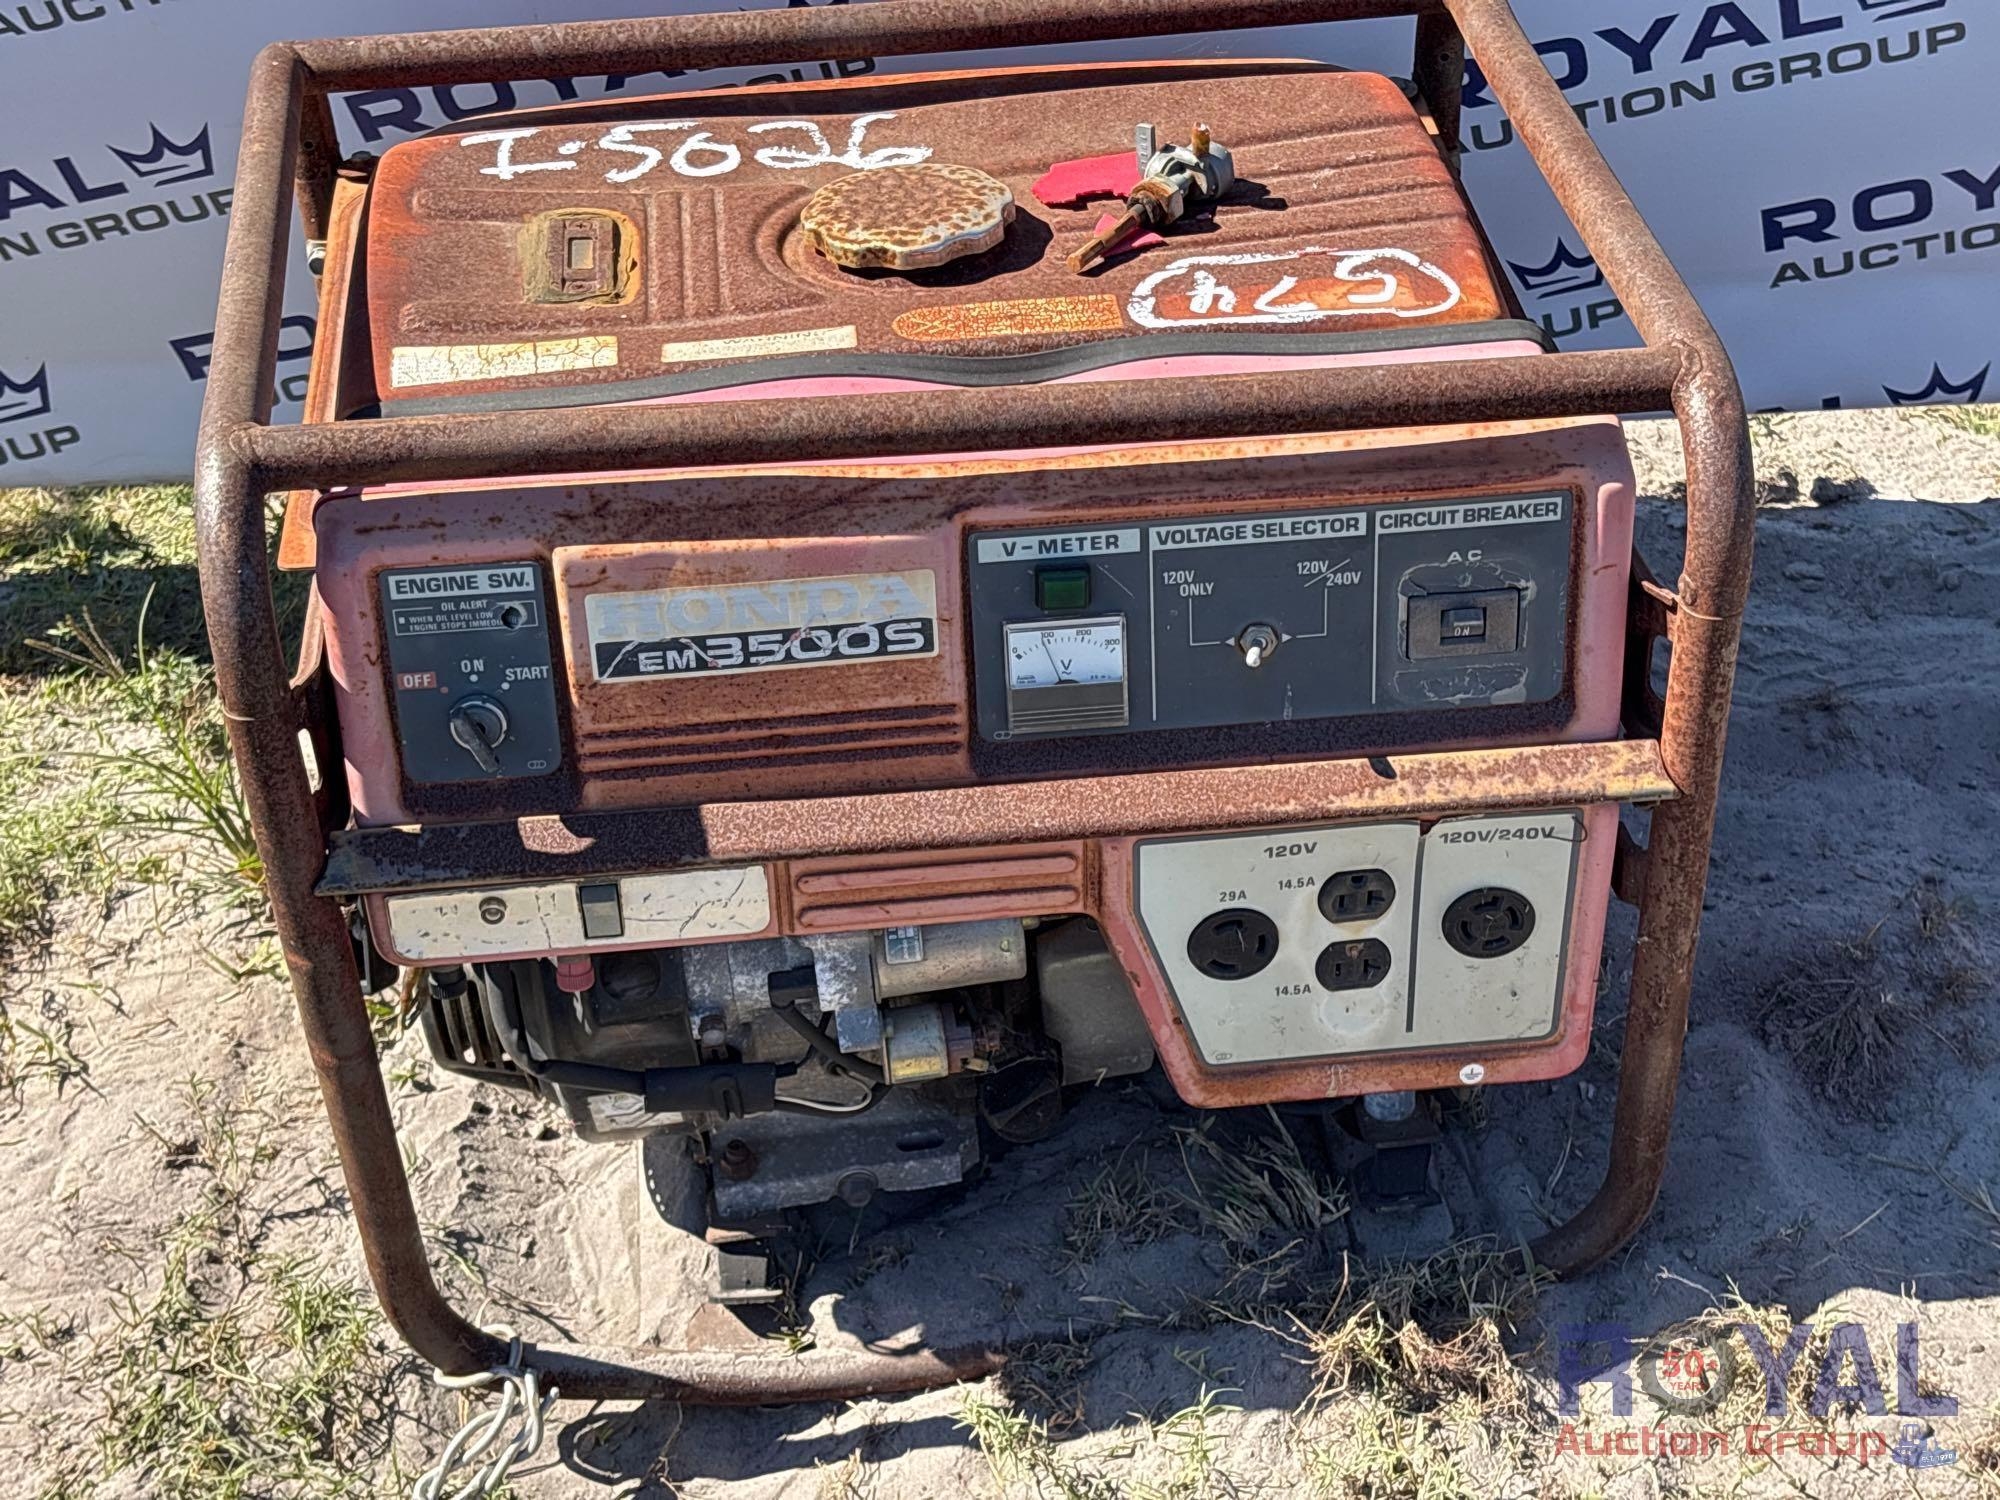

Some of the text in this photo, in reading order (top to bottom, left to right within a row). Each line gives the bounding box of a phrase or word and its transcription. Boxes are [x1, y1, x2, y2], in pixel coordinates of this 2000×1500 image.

[1731, 22, 1967, 94] GROUP
[1379, 502, 1559, 530] CIRCUIT BREAKER
[1156, 517, 1360, 546] VOLTAGE SELECTOR
[1297, 560, 1329, 575] 120V
[395, 571, 531, 595] ENGINE SW.
[1162, 570, 1195, 585] 120V
[1326, 571, 1361, 587] 240V
[1179, 582, 1214, 597] ONLY
[441, 600, 488, 611] OIL ALERT
[598, 575, 928, 637] HONDA
[409, 611, 494, 624] WHEN OIL LEVEL LOW
[409, 624, 438, 632] ENGINE
[441, 622, 467, 630] STOPS
[1454, 626, 1470, 636] ON
[460, 659, 485, 673] ON
[1060, 659, 1072, 670] V
[505, 665, 549, 681] START
[403, 674, 432, 688] OFF
[1438, 825, 1556, 845] 120V/240V
[1263, 841, 1318, 860] 120V
[1277, 876, 1316, 891] 14.5A
[1219, 889, 1247, 903] 29A
[1274, 983, 1312, 998] 14.5A
